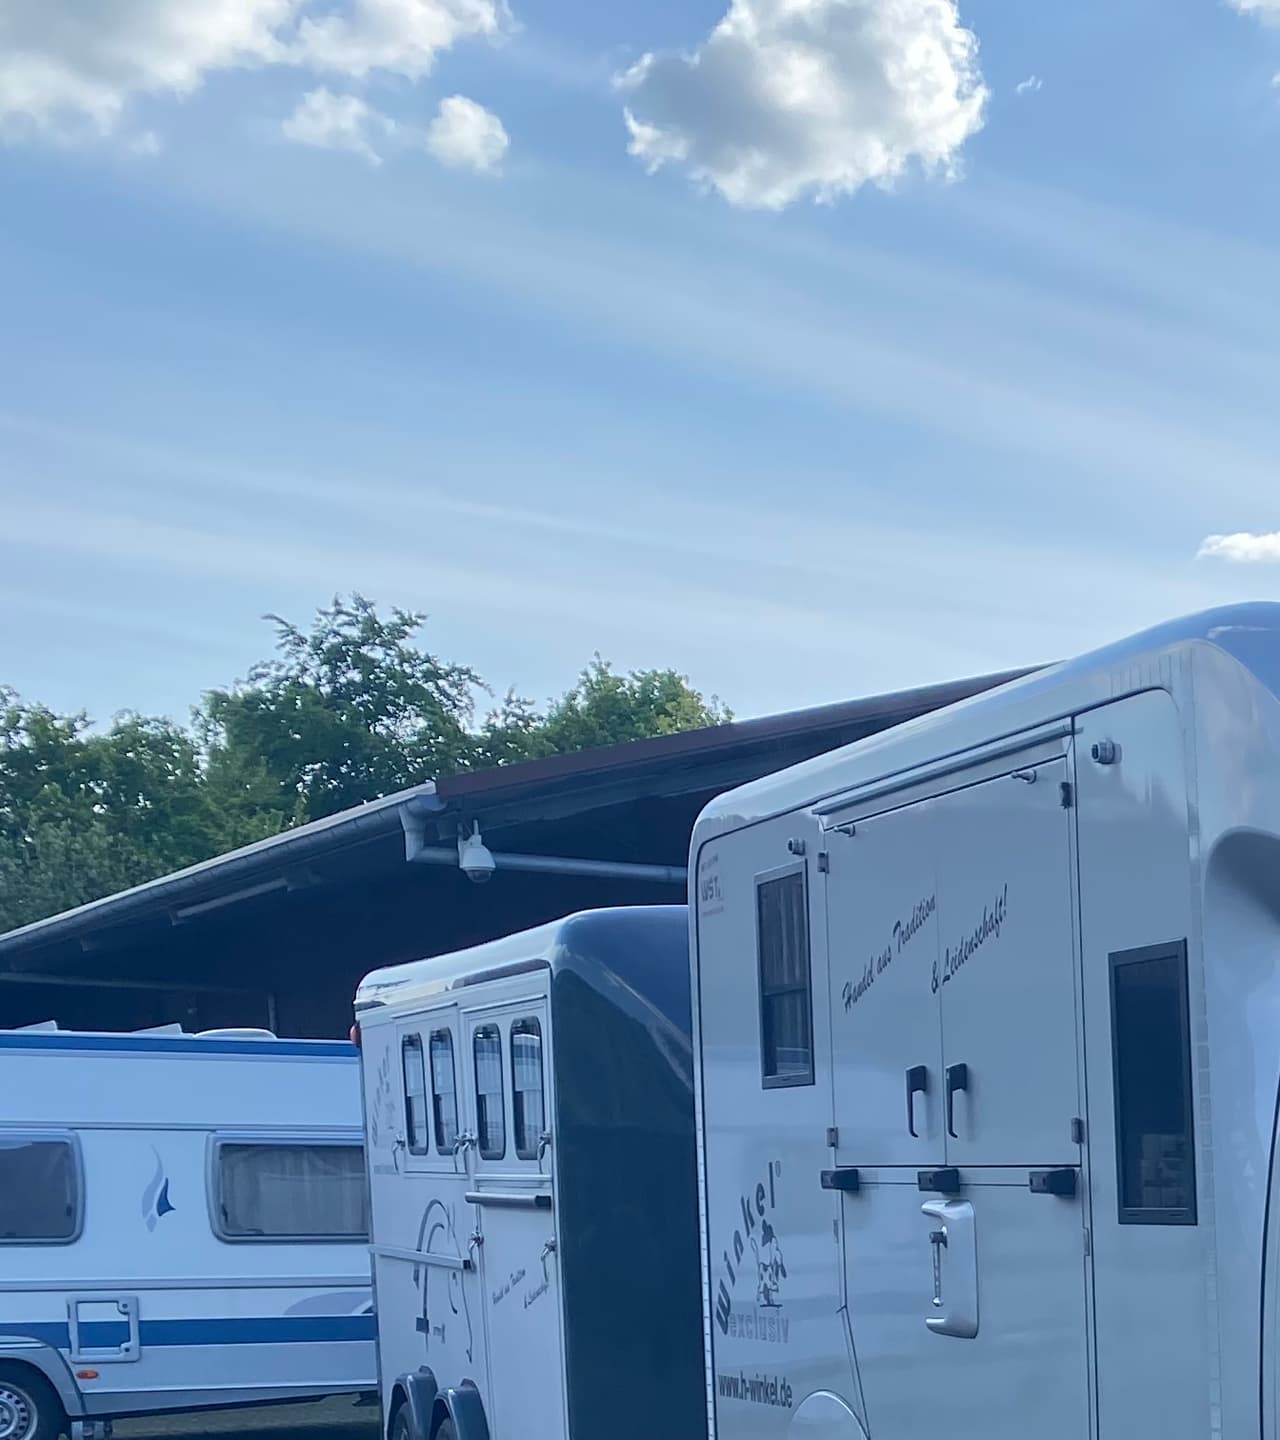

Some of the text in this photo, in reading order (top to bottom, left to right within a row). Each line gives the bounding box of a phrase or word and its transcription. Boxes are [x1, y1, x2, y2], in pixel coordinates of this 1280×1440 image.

[842, 893, 936, 1014] Handel aus Tradition
[931, 883, 1008, 994] & Leidenschaft!
[717, 1370, 793, 1408] www.h-winkel.de
